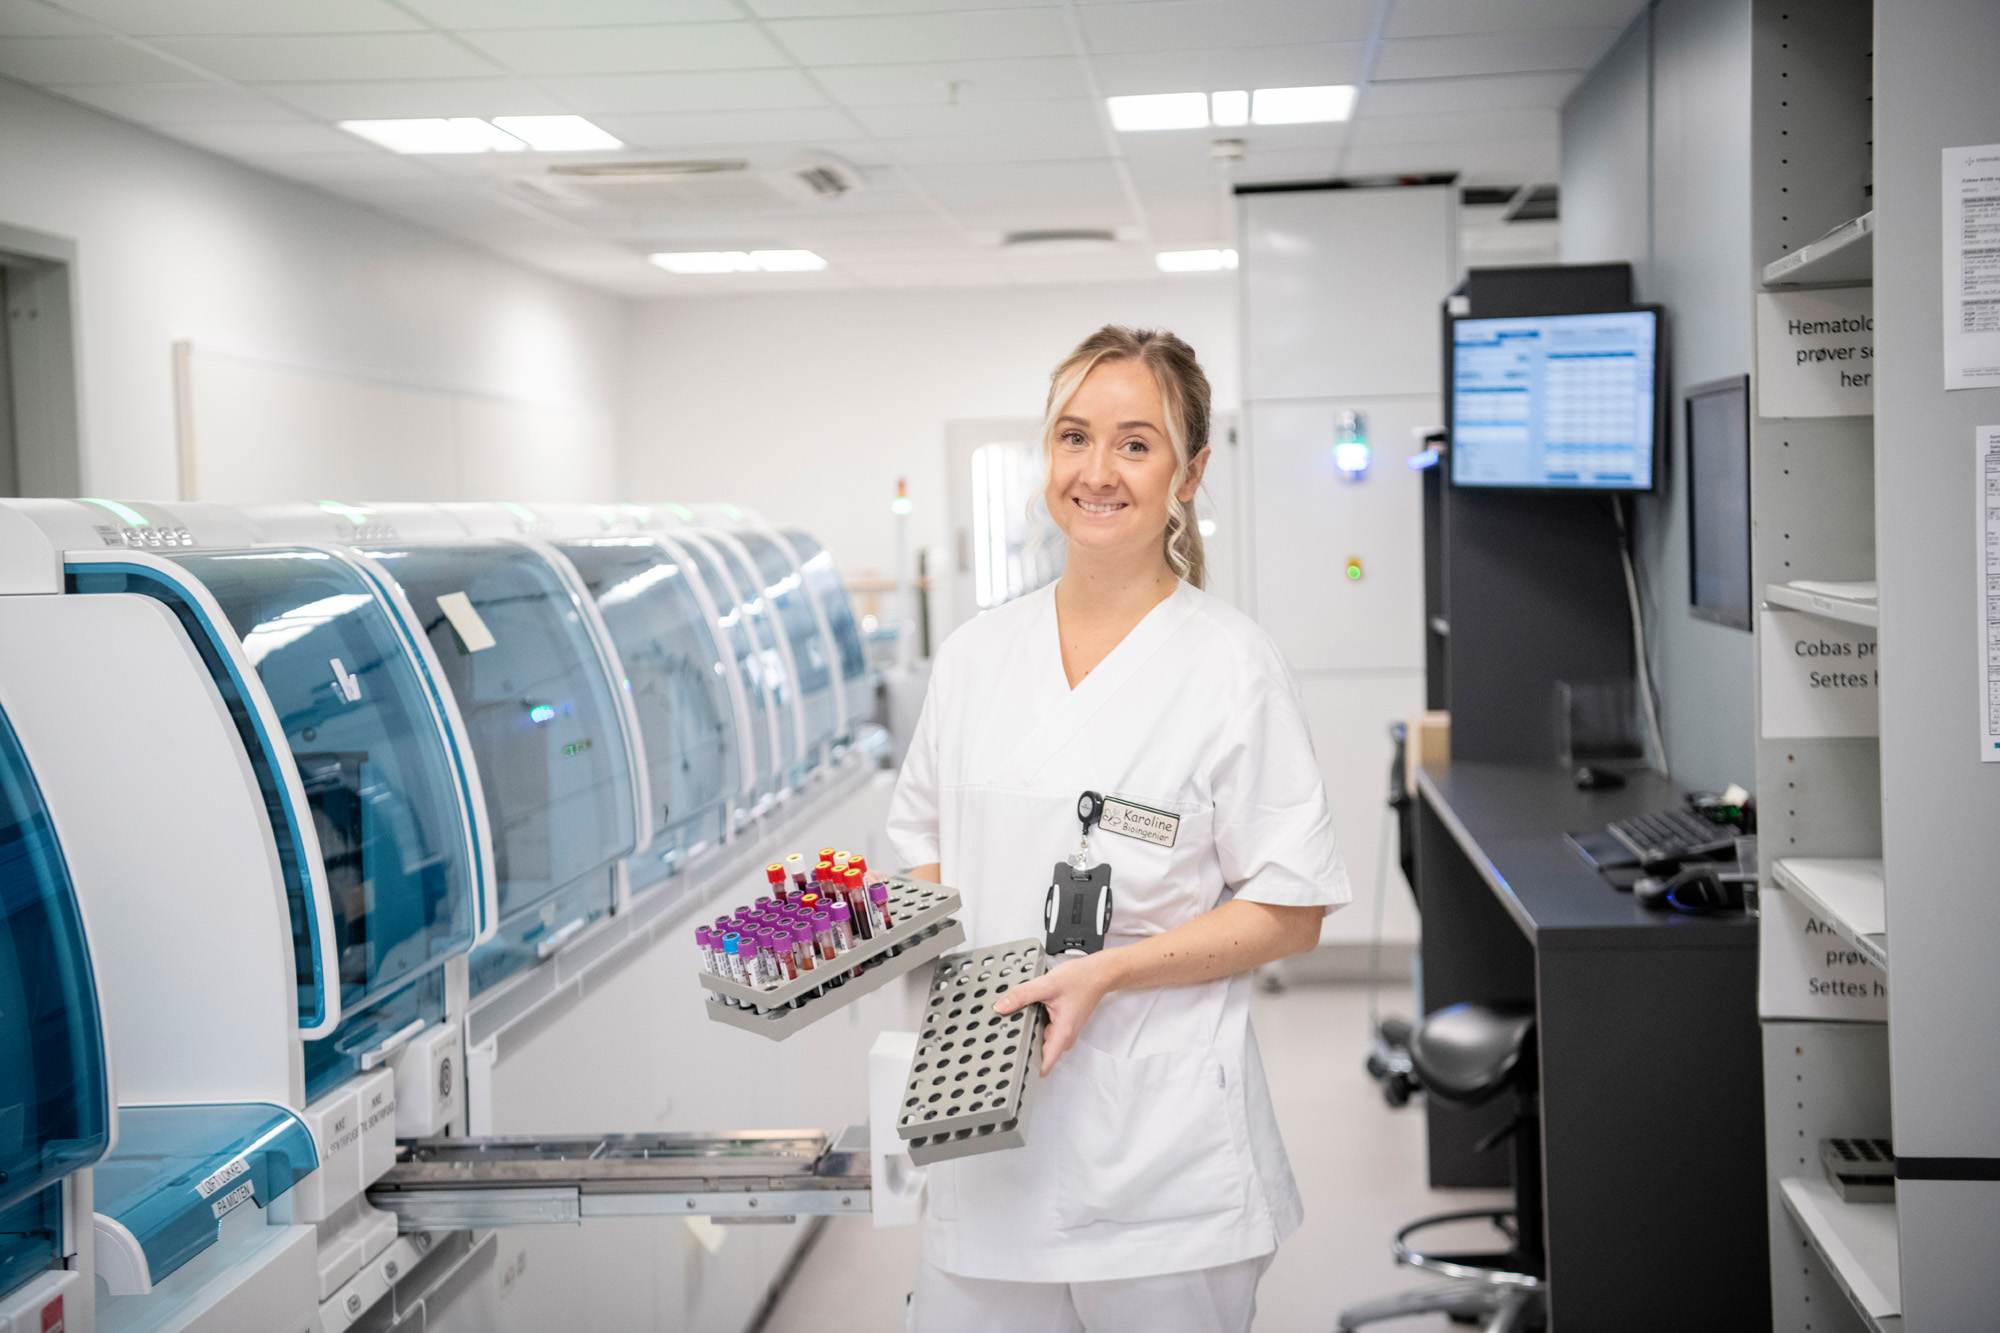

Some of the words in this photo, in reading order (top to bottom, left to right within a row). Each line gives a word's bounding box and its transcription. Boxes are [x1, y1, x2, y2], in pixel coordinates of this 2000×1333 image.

[1797, 347, 1856, 366] prøver
[1861, 346, 1874, 359] s
[1841, 370, 1872, 387] her
[1795, 639, 1852, 657] Cobas
[1810, 671, 1868, 688] Settes
[1124, 809, 1173, 832] Karoline
[1123, 822, 1170, 842] Bioingeniør
[1826, 950, 1876, 968] prøv
[1809, 977, 1867, 997] Settes
[1873, 980, 1888, 998] h
